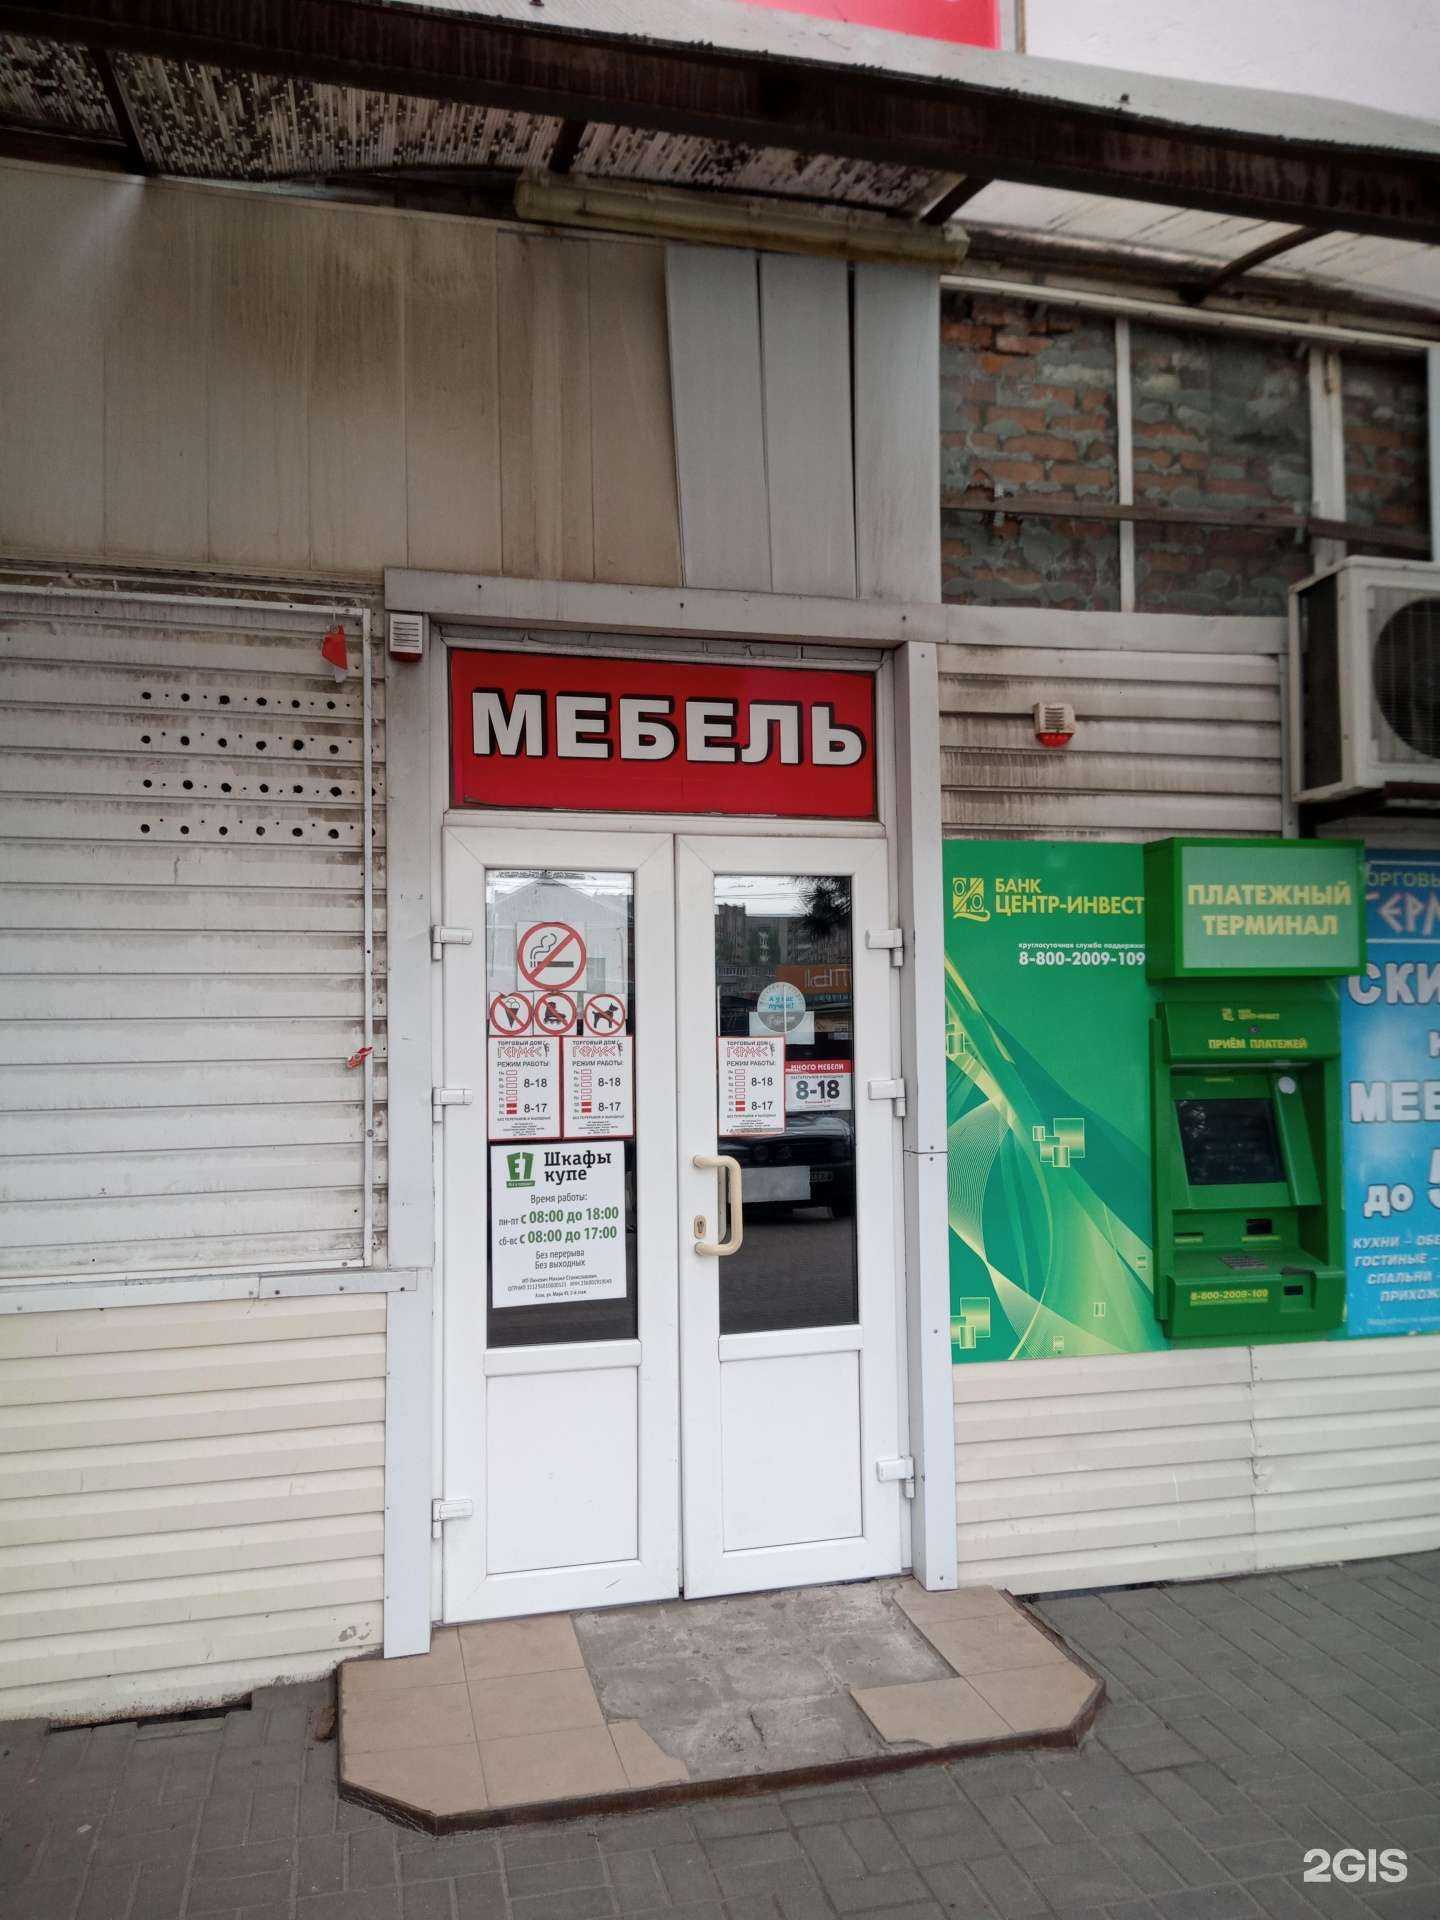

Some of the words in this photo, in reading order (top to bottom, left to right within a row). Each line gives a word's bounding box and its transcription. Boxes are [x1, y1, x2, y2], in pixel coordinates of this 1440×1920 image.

[472, 688, 866, 766] МЕБЕЛЬ
[995, 878, 1042, 894] БАНК
[1188, 881, 1351, 906] ПЛАТЕЖНЫЙ
[995, 895, 1145, 916] ЦЕНТР-ИНВЕСТ
[1201, 914, 1339, 936] ТЕРМИНАЛ
[1019, 951, 1146, 966] 8-800-2009-109
[1208, 1037, 1246, 1049] ПРИЁМ
[1250, 1036, 1307, 1049] ПЛАТЕЖЕЙ
[524, 1078, 548, 1088] 8-18
[598, 1077, 622, 1087] 8-18
[752, 1077, 773, 1086] 8-18
[796, 1080, 840, 1100] 8-18
[524, 1103, 548, 1113] 8-17
[598, 1102, 622, 1112] 8-17
[752, 1101, 773, 1111] 8-17
[544, 1150, 612, 1168] Шкафы
[544, 1169, 587, 1185] купе
[530, 1194, 556, 1205] Время
[557, 1193, 588, 1204] работы:
[498, 1218, 519, 1226] пн-пт
[529, 1210, 564, 1224] 08:00
[566, 1211, 582, 1224] до
[586, 1206, 619, 1221] 18:00
[498, 1237, 518, 1246] сб-вс
[528, 1229, 562, 1243] 08:00
[565, 1231, 581, 1244] до
[584, 1226, 617, 1240] 17:00
[1353, 1236, 1400, 1249] КУХНИ
[536, 1250, 548, 1260] Без
[550, 1250, 585, 1260] перерыва
[1354, 1252, 1428, 1267] ГОСТИНЫЕ
[535, 1261, 547, 1270] Без
[549, 1260, 586, 1269] выходных
[1368, 1271, 1432, 1285] СПАЛЬНИ
